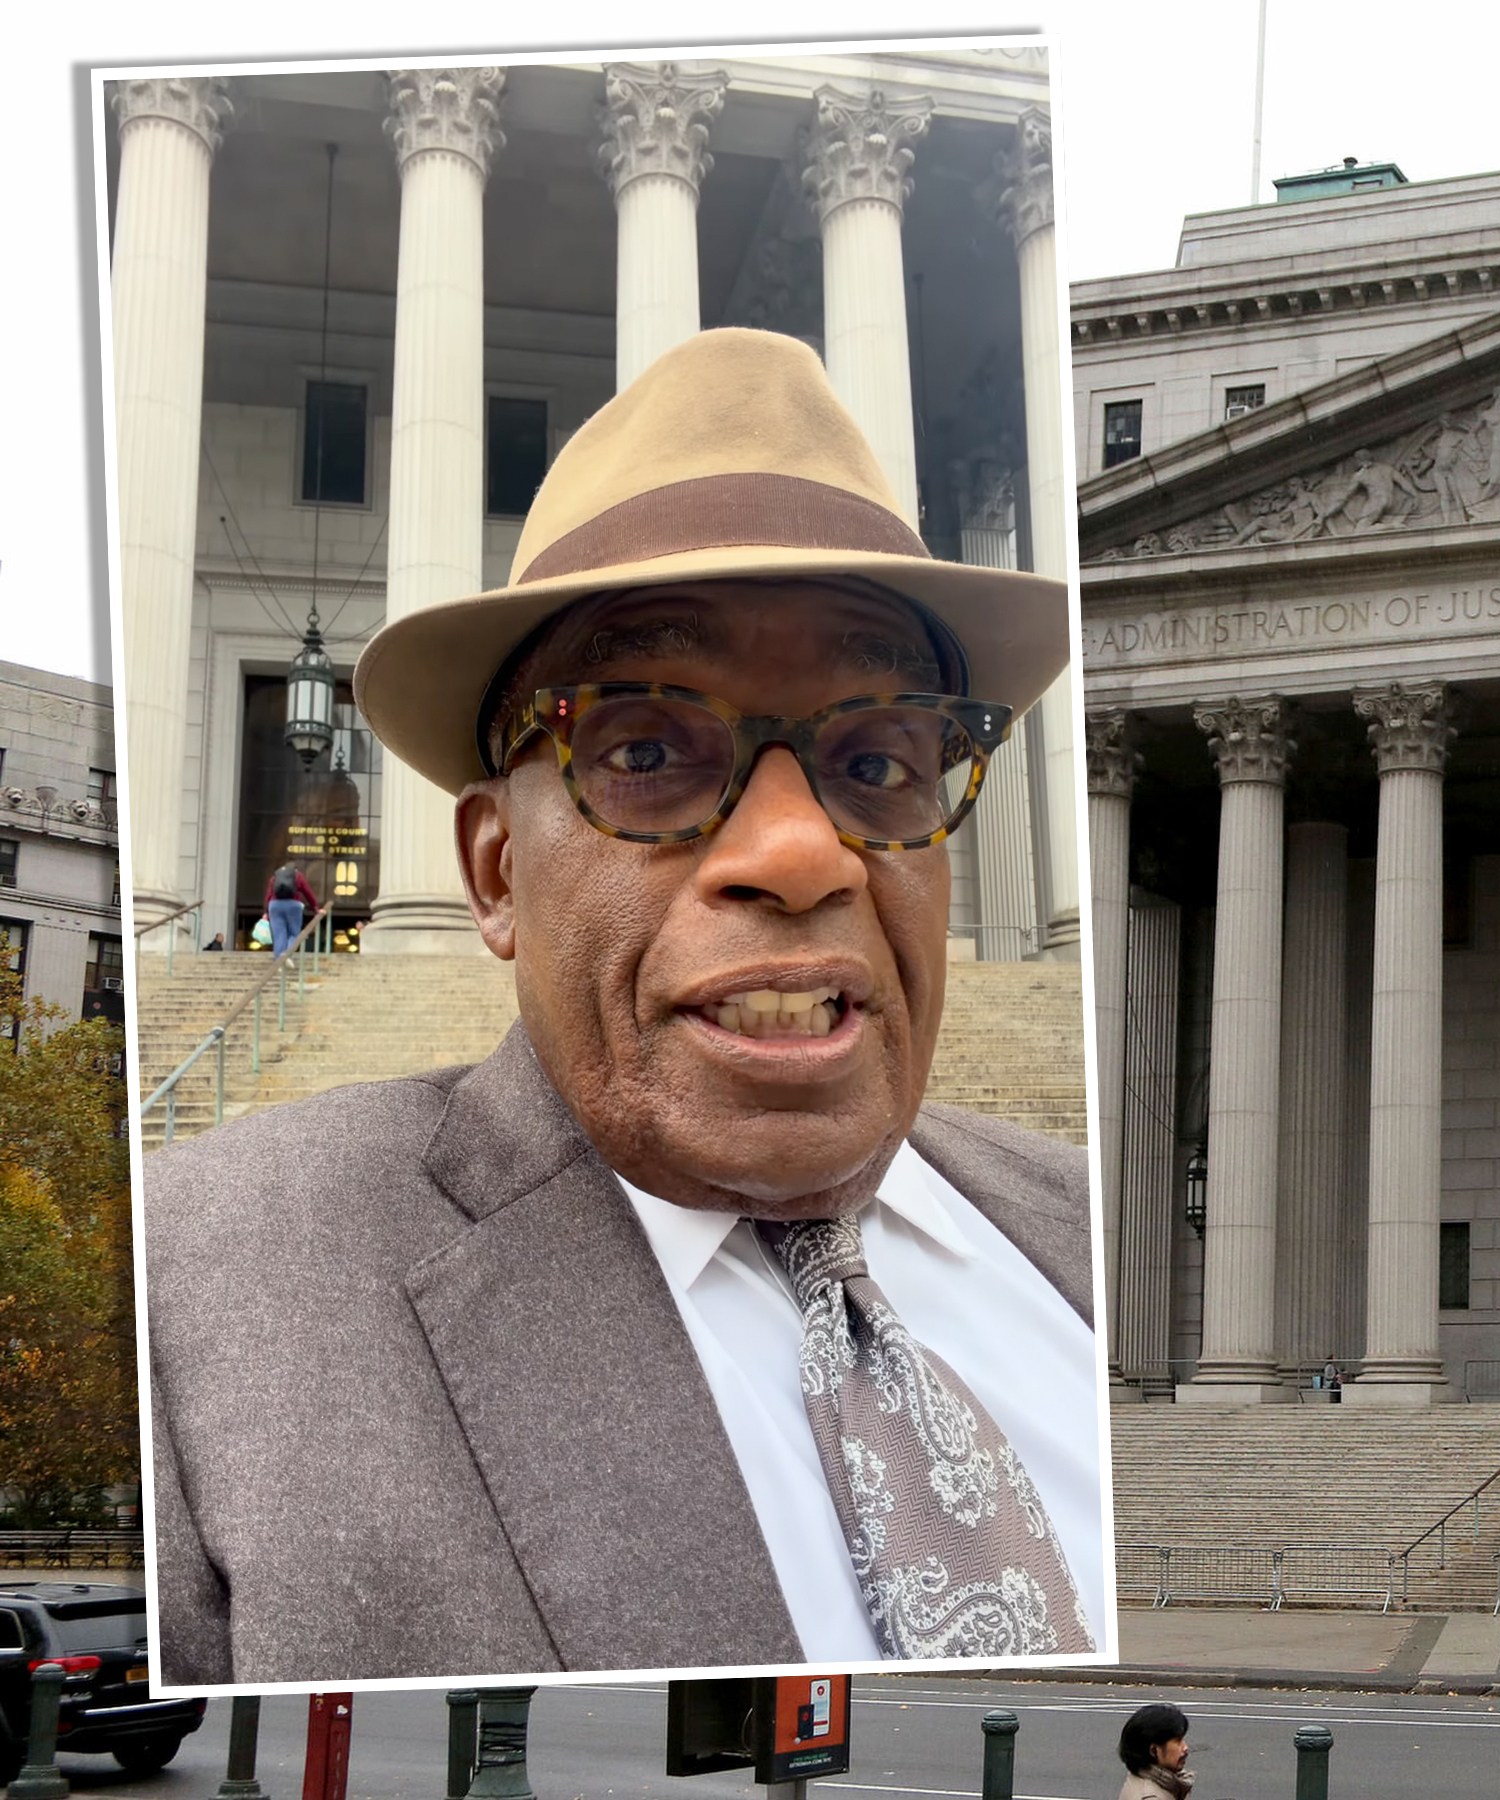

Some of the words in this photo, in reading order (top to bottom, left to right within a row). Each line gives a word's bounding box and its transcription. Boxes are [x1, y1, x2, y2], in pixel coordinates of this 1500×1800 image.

[1098, 601, 1371, 656] ADMINISTRATION
[1384, 594, 1431, 627] OF
[288, 826, 335, 835] SUPREME
[328, 846, 367, 855] STREET
